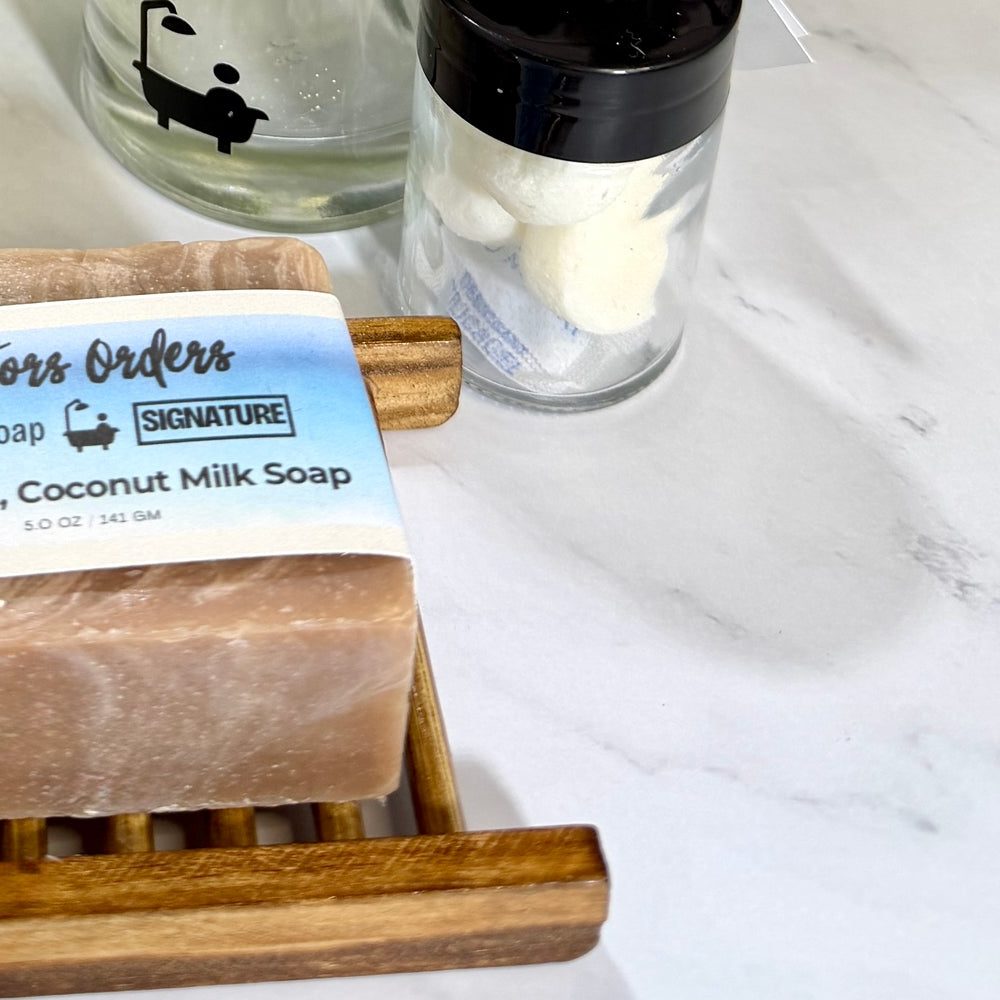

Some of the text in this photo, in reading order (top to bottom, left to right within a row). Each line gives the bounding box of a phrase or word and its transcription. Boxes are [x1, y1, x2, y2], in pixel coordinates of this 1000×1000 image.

[85, 328, 236, 388] Orders
[141, 403, 286, 432] SIGNATURE
[17, 471, 172, 504] Coconut
[180, 462, 255, 491] Milk
[263, 462, 353, 492] Soap
[58, 516, 82, 528] OZ
[99, 513, 128, 525] 141
[133, 509, 162, 522] GM
